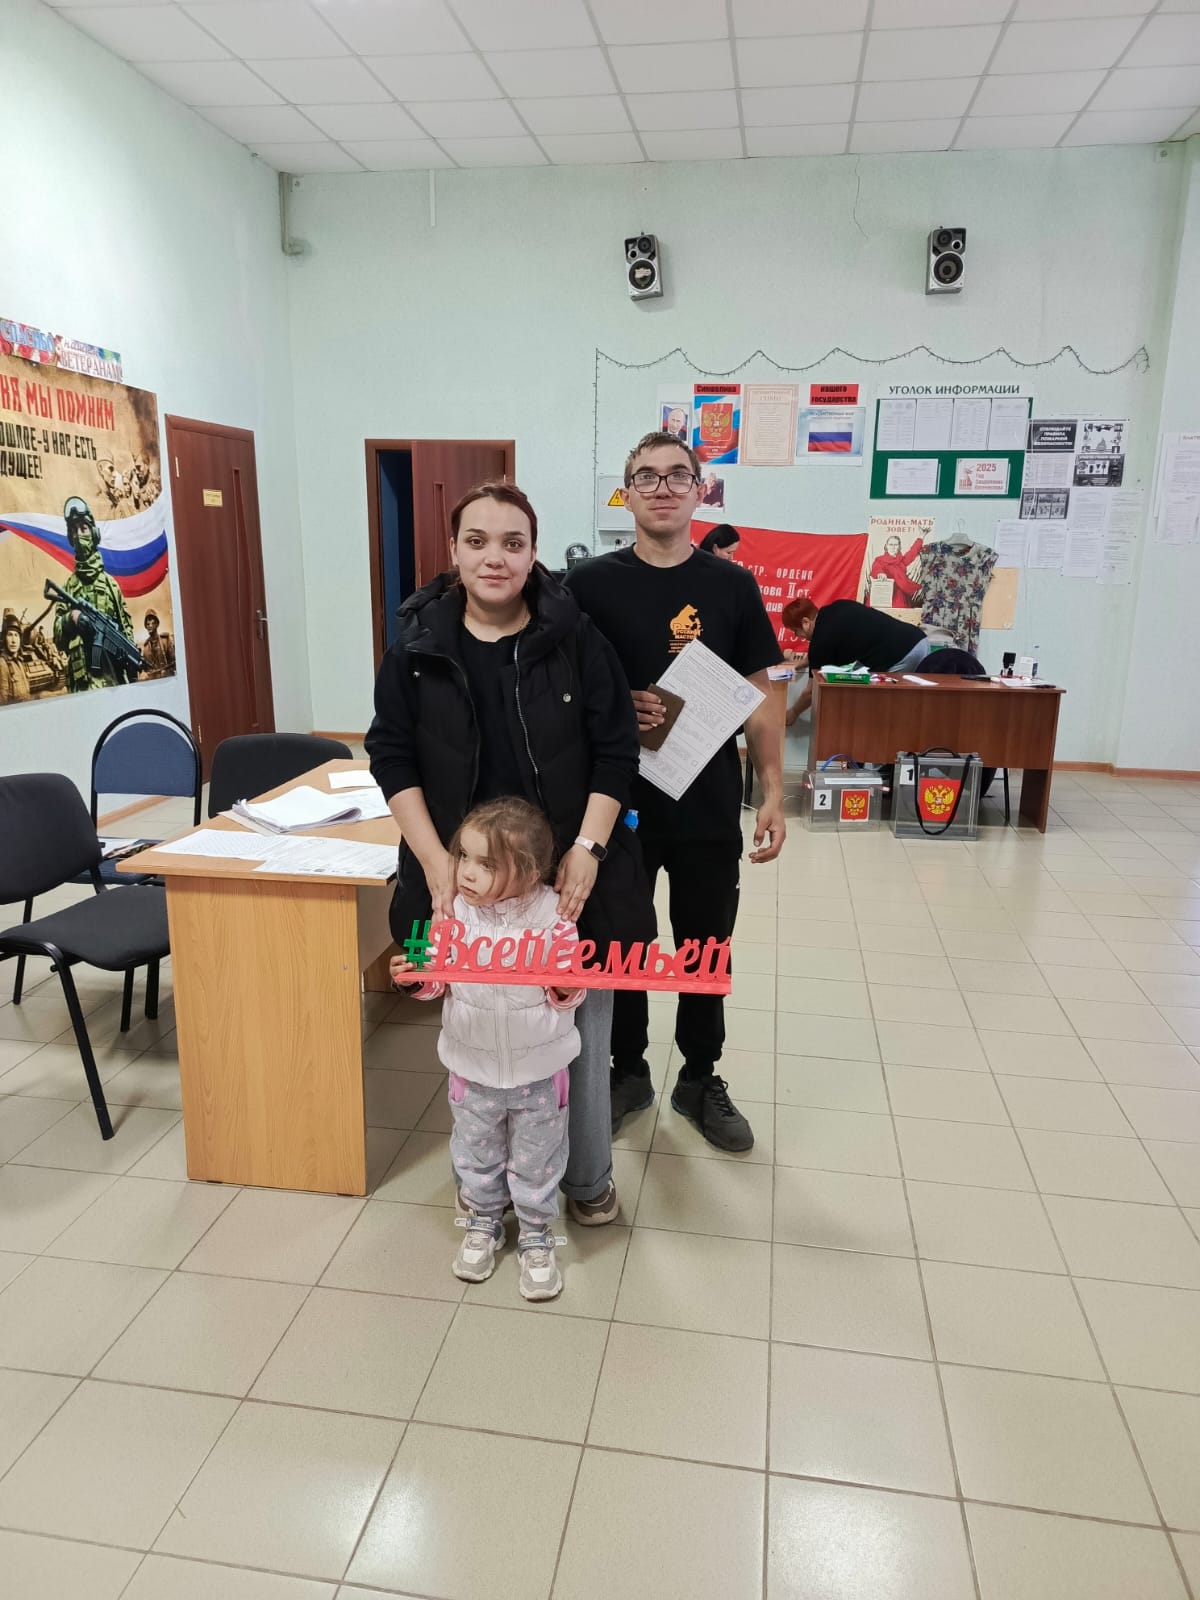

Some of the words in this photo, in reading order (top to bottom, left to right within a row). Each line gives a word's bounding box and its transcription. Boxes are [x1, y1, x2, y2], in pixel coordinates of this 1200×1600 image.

[889, 386, 932, 395] УГОЛОК
[935, 385, 1020, 395] ИНФОРМАЦИИ
[26, 380, 53, 419] МЫ
[57, 388, 115, 431] ПОМНИМ
[51, 431, 71, 456] НАС
[75, 435, 97, 461] ЕСТЬ
[976, 463, 997, 472] 2025
[870, 518, 934, 526] РОДИНА-МАТЬ
[776, 567, 814, 581] ОРДЕНА
[907, 768, 914, 782] 1
[819, 793, 827, 806] 2
